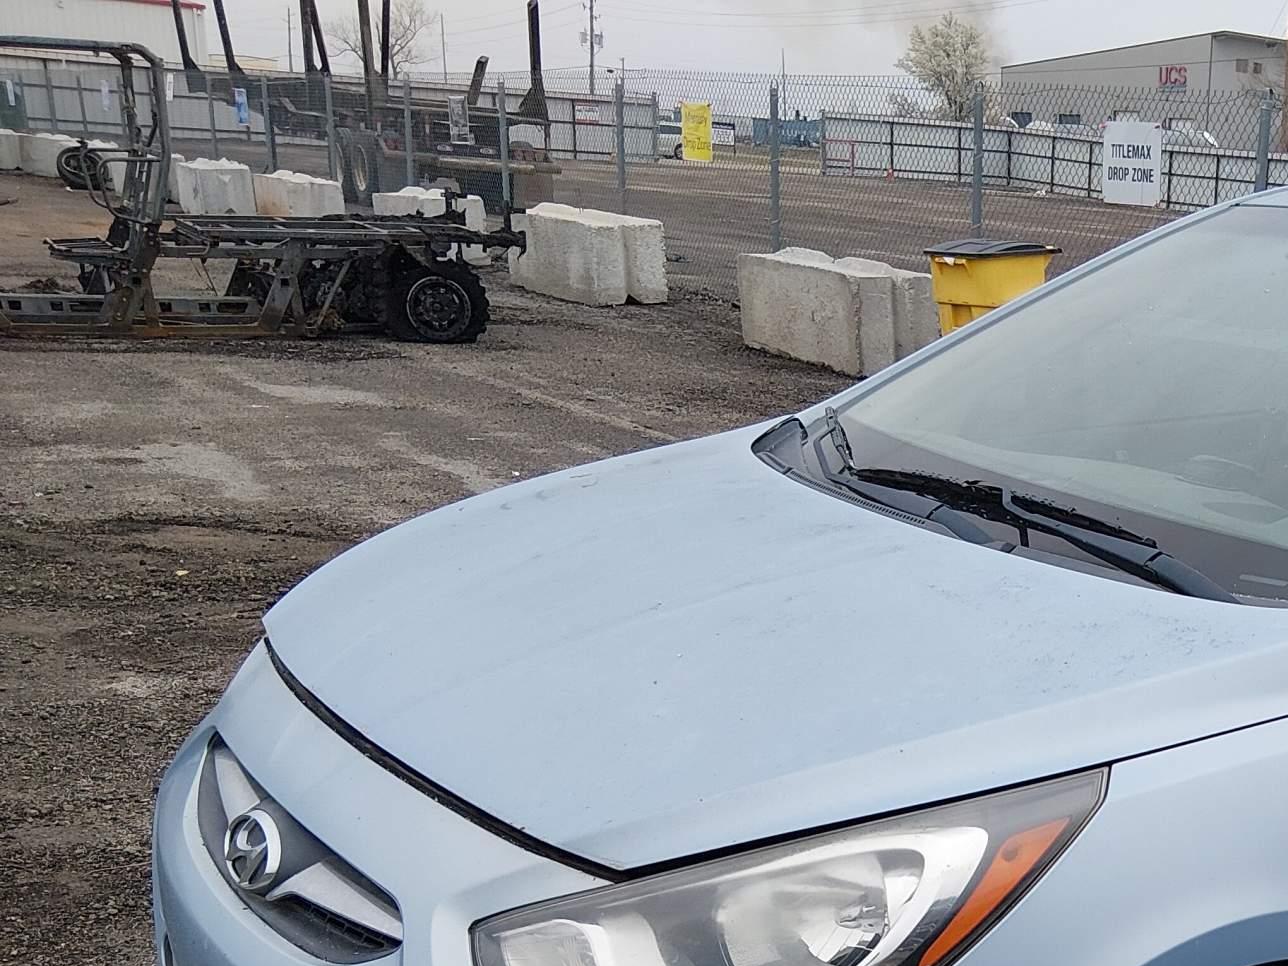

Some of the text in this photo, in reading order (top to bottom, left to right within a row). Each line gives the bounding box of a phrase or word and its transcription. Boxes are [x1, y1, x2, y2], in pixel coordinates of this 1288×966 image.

[1159, 66, 1188, 85] UCS
[1111, 143, 1152, 160] TITLEMAX
[1107, 166, 1154, 183] DROP ZONE
